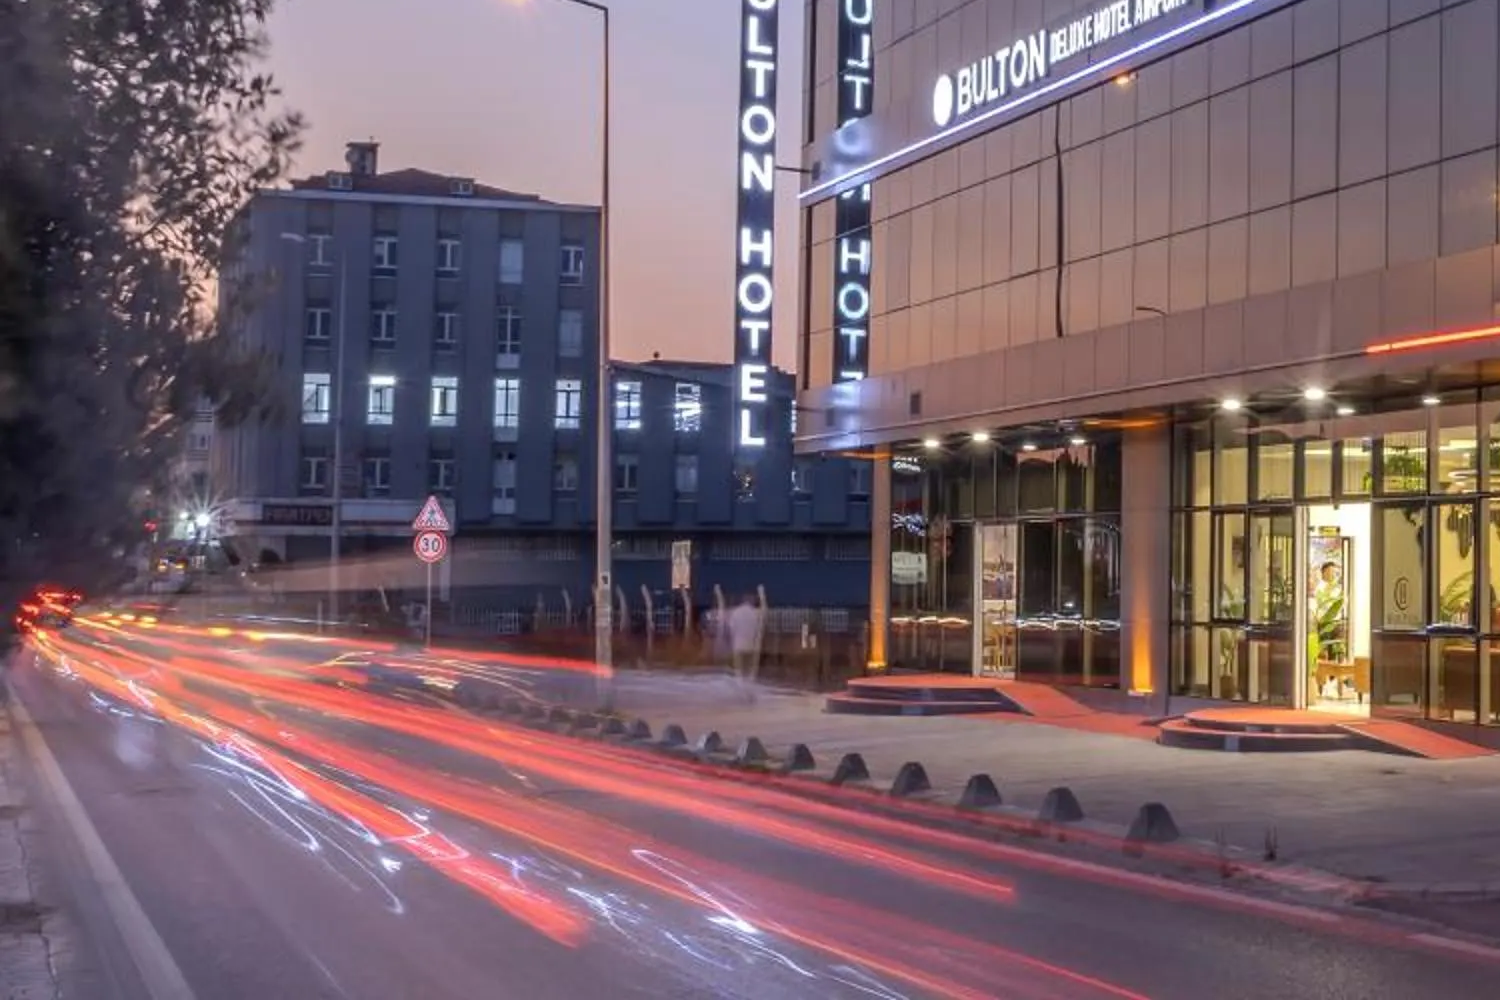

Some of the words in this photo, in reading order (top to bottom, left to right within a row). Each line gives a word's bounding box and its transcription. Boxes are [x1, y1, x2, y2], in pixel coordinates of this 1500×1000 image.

[956, 28, 1046, 116] BULTON
[1050, 12, 1094, 64] DELUXE
[739, 226, 773, 446] HOTEL
[422, 537, 440, 553] 30
